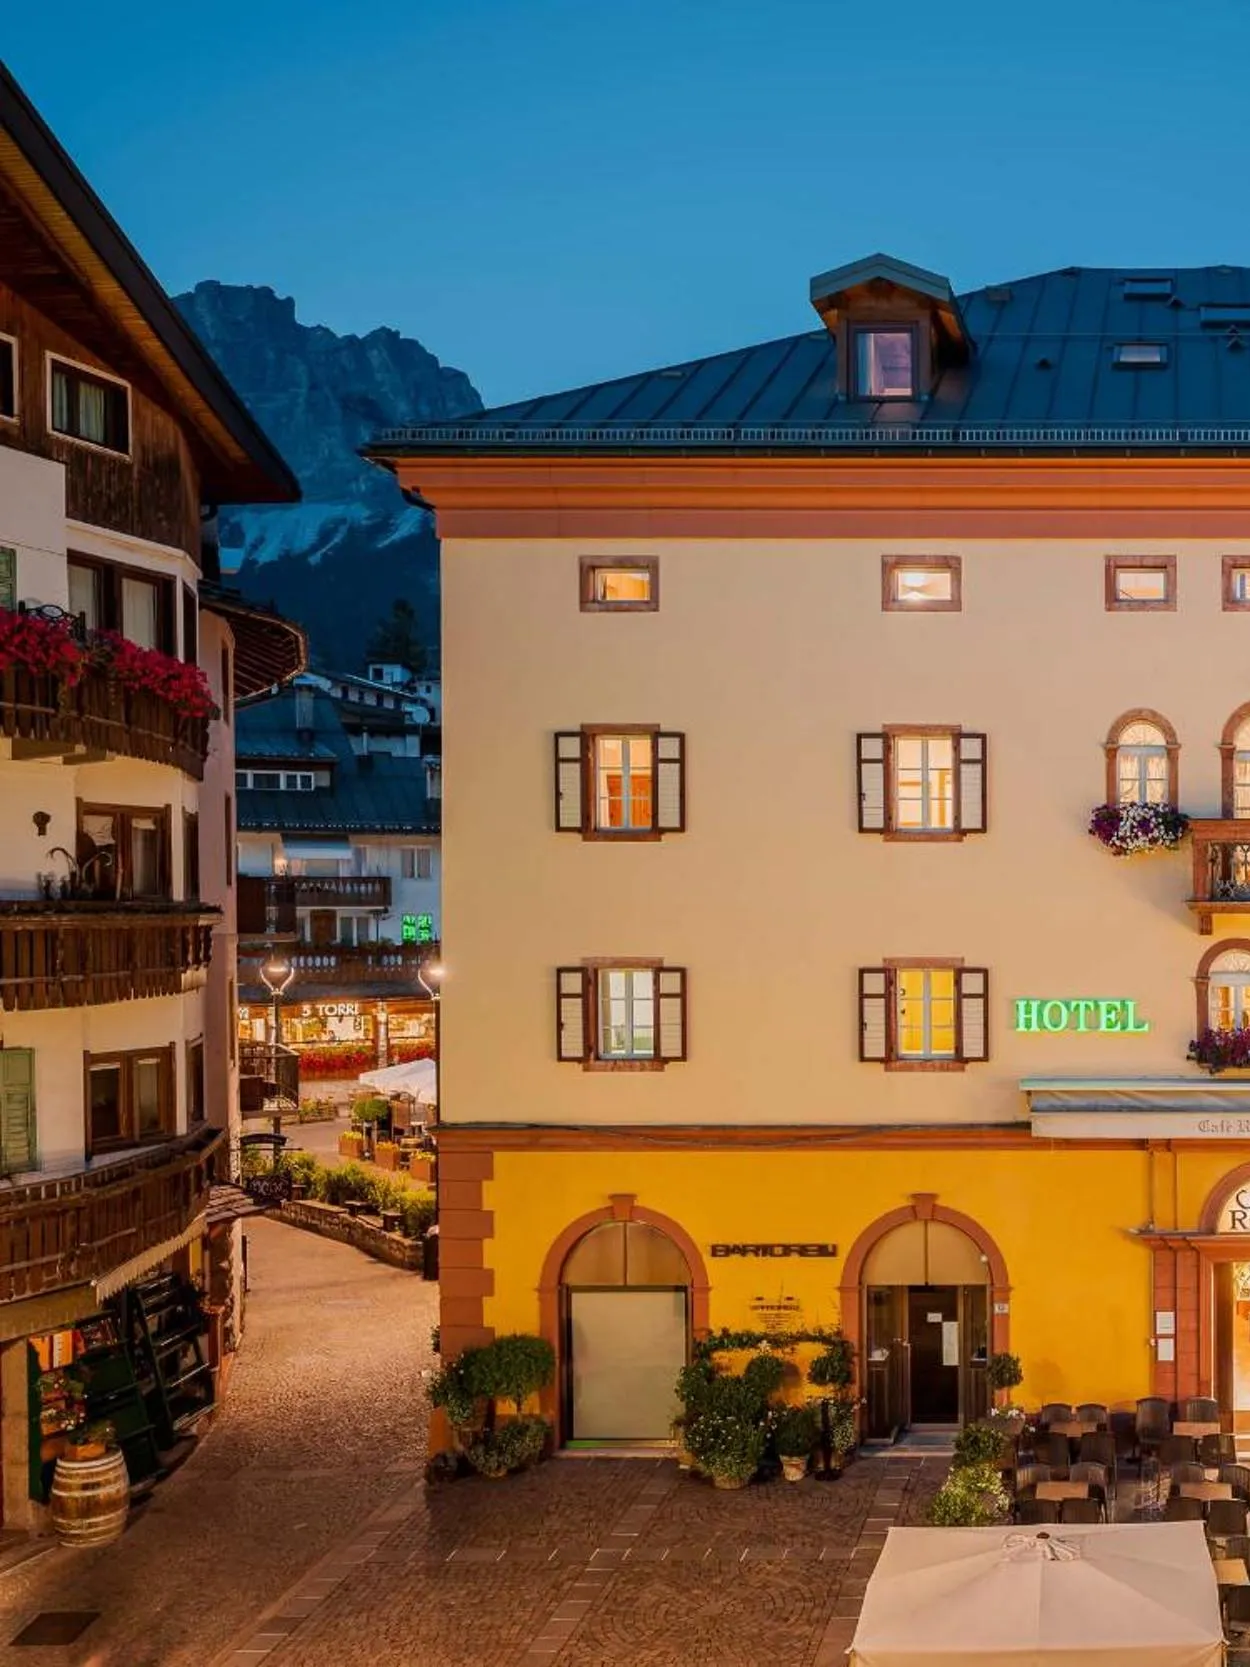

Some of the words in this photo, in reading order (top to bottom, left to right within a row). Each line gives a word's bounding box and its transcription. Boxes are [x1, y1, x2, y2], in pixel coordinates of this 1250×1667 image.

[301, 1004, 312, 1016] 5
[316, 1003, 360, 1016] TORRI
[1015, 999, 1149, 1032] HOTEL
